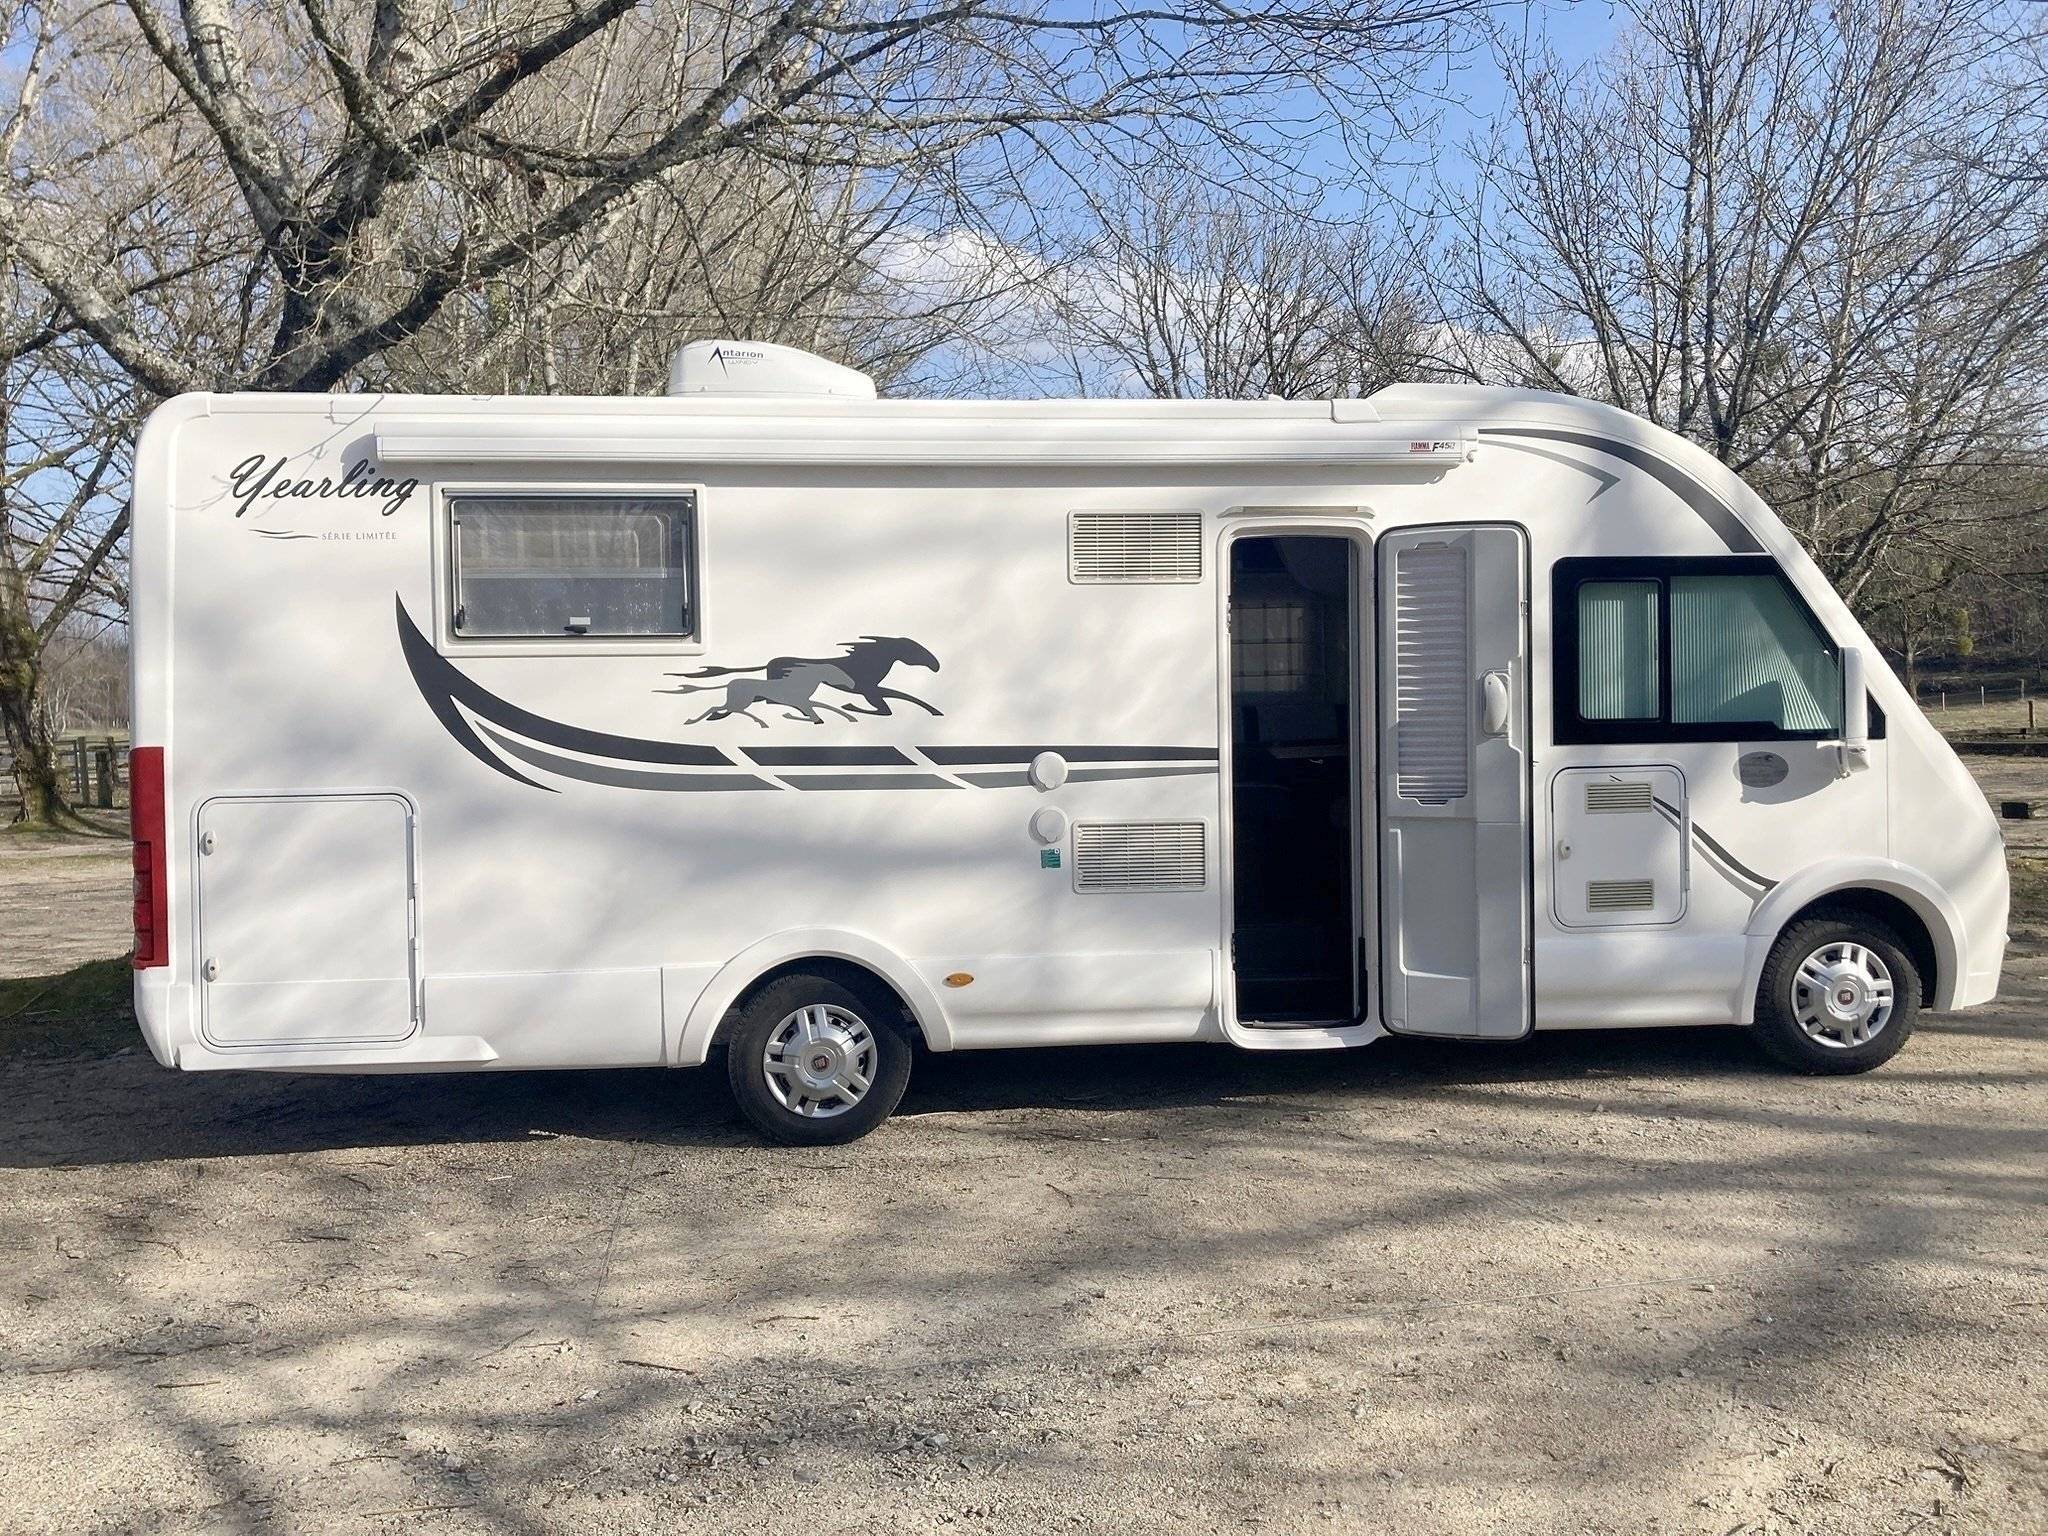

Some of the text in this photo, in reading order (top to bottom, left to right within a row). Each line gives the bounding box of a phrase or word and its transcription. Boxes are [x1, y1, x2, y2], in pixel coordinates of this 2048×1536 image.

[707, 346, 764, 380] Antarion
[230, 454, 419, 518] Yearling
[321, 531, 397, 541] SÉRIE LIMITÉE
